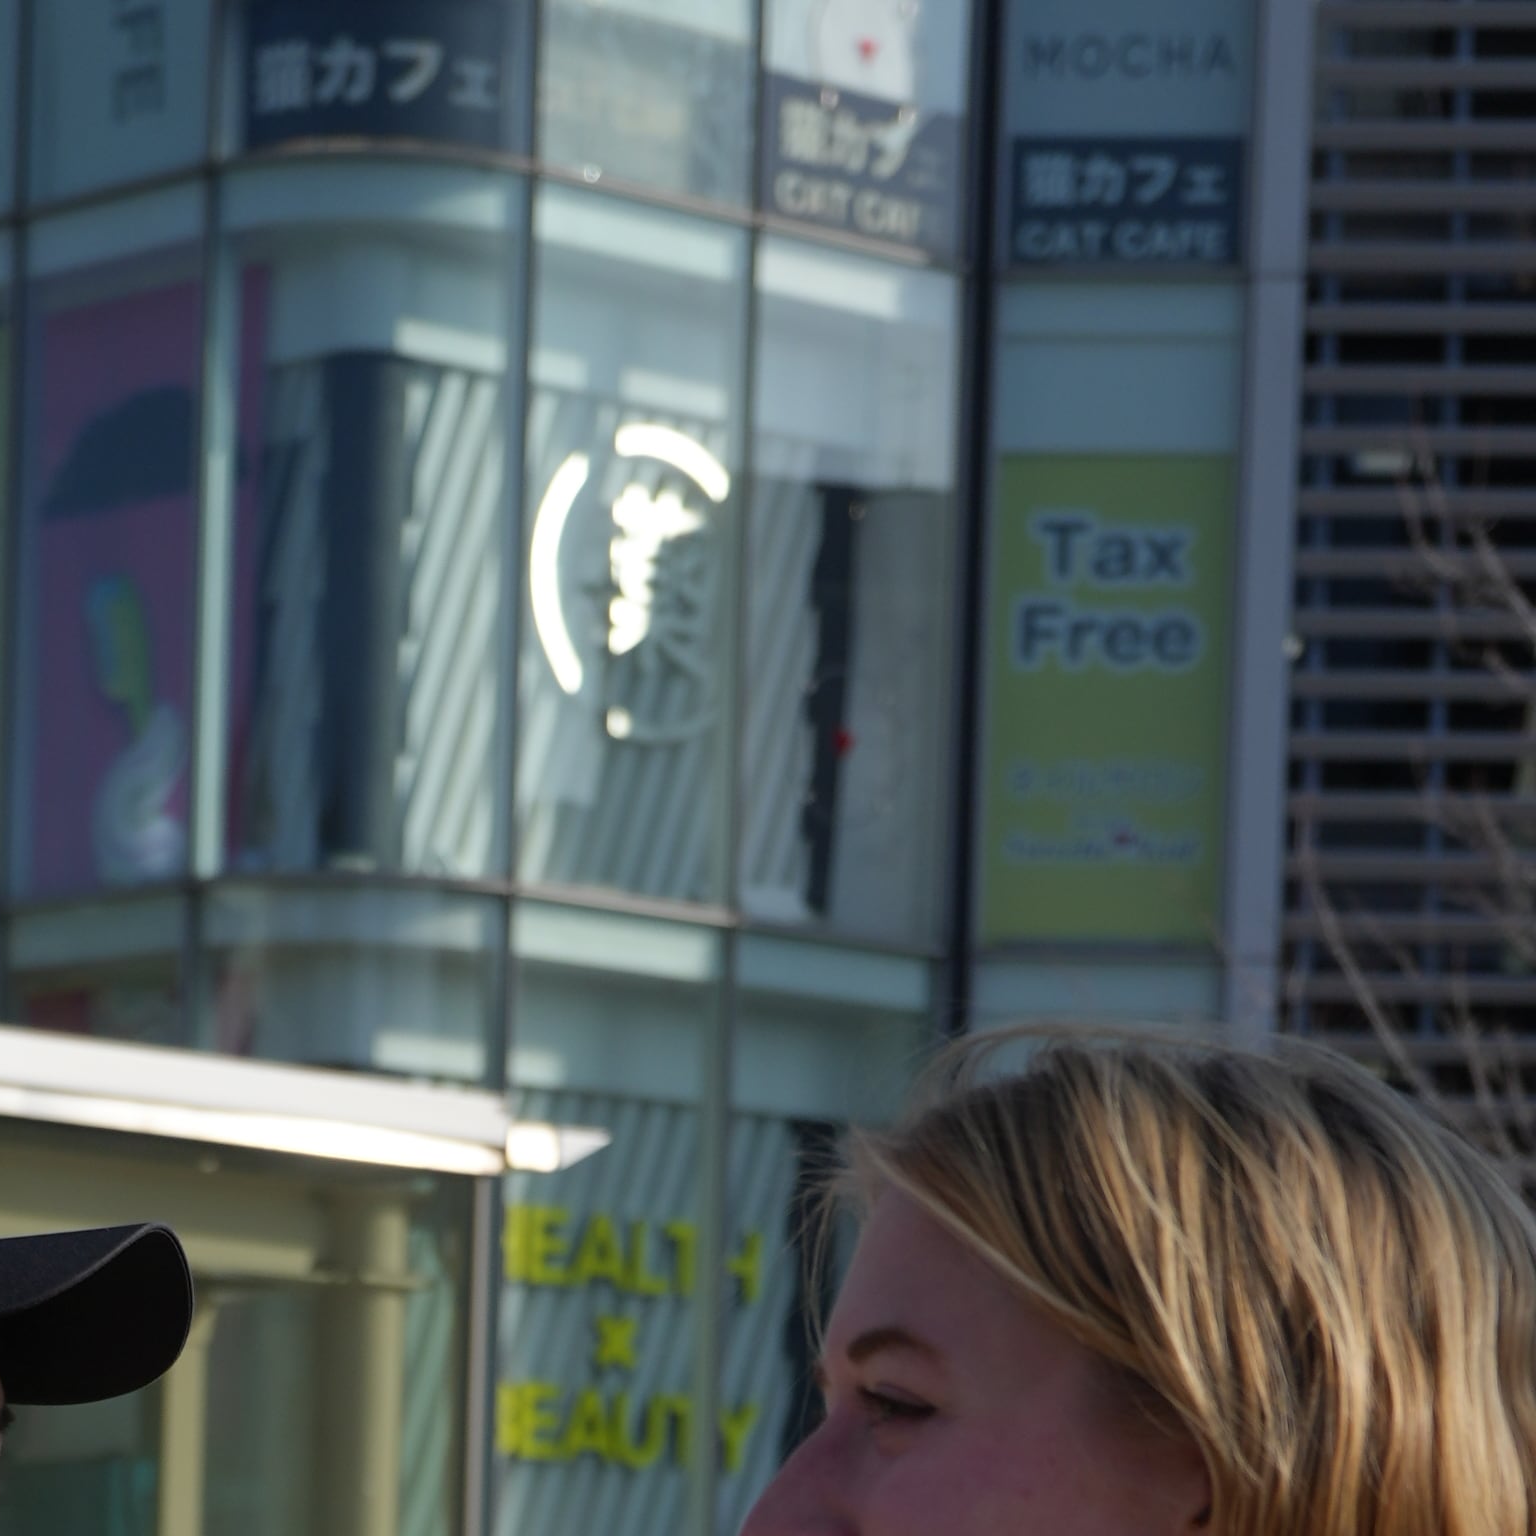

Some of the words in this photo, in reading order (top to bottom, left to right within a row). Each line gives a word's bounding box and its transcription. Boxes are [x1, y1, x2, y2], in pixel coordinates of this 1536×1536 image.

[1022, 32, 1238, 81] MOCHA
[1017, 218, 1105, 261] CAT
[1114, 217, 1227, 261] CAFE
[1032, 511, 1193, 588] Tax
[1014, 602, 1202, 669] Free
